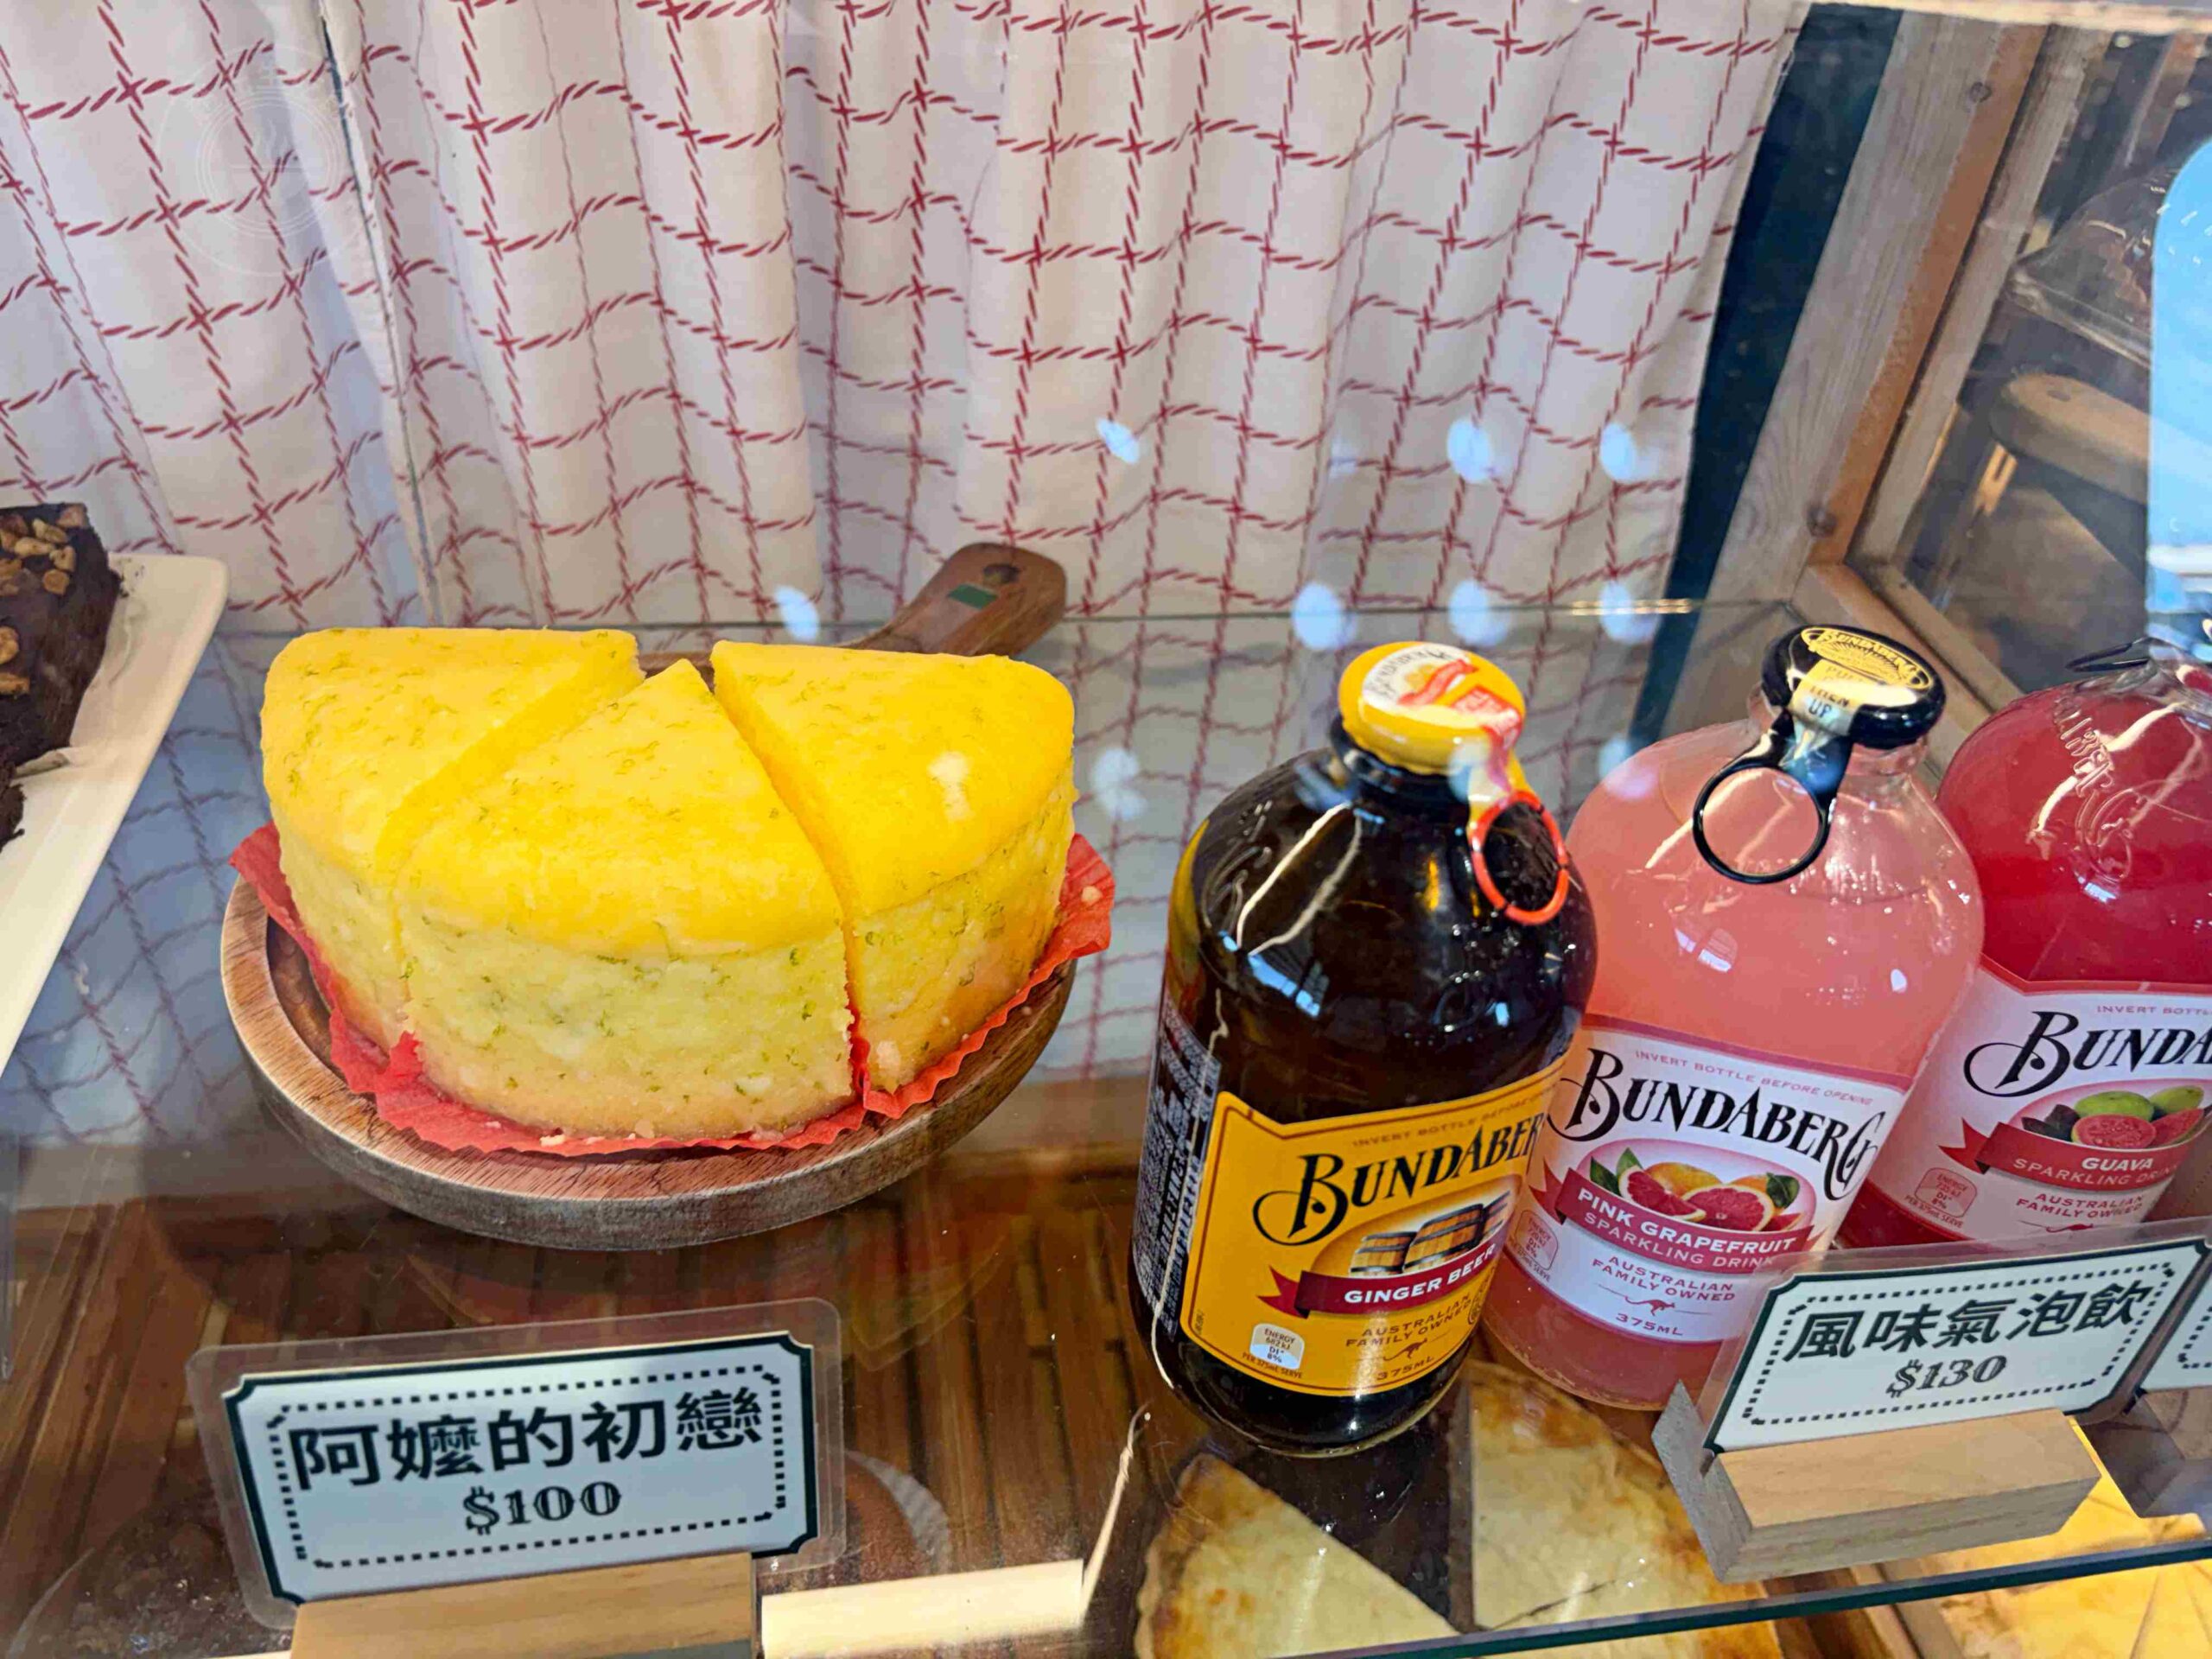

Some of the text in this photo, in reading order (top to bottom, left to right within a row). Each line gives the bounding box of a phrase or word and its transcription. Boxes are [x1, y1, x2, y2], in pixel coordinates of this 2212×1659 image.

[1808, 698, 1833, 718] UP
[2097, 1005, 2212, 1015] INVERT BOTTL
[1635, 1051, 1688, 1067] INVERT
[1694, 1063, 1755, 1083] BOTTLE
[1761, 1077, 1821, 1095] BEFORE
[1963, 1011, 2212, 1097] BUNDA
[1352, 1130, 1412, 1147] INVERT
[1547, 1047, 1887, 1202] BUNDABERG
[1252, 1111, 1545, 1247] BUNDABER
[2012, 1158, 2130, 1185] SPARKLING
[2082, 1156, 2154, 1172] GUAVA
[1578, 1188, 1797, 1254] PINK GRAPEFRUIT
[2016, 1198, 2083, 1218] FAMILY
[2035, 1193, 2144, 1209] AUSTRALIAN
[1584, 1212, 1704, 1264] SPARKLING
[1344, 1277, 1443, 1304] GINGER
[1446, 1243, 1497, 1285] BEER
[1592, 1258, 1736, 1301] FAMILY OWNED
[1608, 1255, 1734, 1292] AUSTRALIAN
[1264, 1327, 1296, 1345] ENERGY
[1362, 1294, 1470, 1337] AUSTRALIAN
[1783, 1279, 2153, 1363] 風味氣泡飲
[1346, 1332, 1414, 1348] FAMILY
[1281, 1367, 1303, 1379] SERVE
[1886, 1354, 2008, 1399] $130
[289, 1386, 763, 1491] 阿嬤的初戀
[462, 1480, 622, 1535] $100
